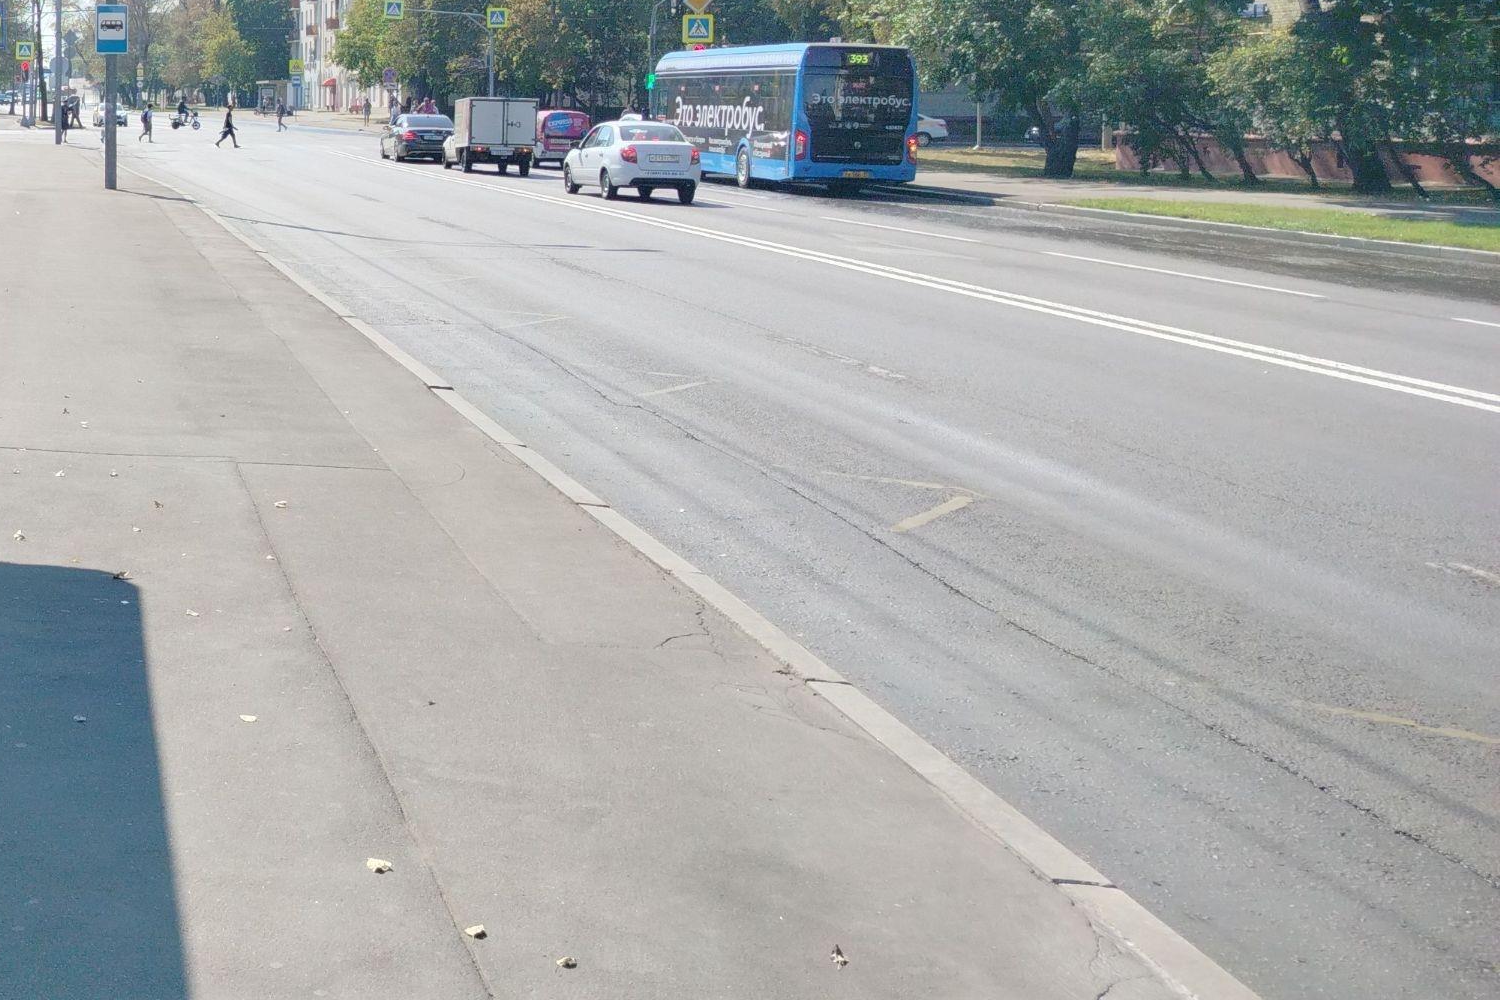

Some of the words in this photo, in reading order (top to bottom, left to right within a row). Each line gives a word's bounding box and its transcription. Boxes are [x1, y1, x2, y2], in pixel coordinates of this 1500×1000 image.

[849, 53, 869, 64] 393
[811, 93, 836, 105] Это
[839, 94, 912, 109] электробус.
[674, 96, 694, 127] Это
